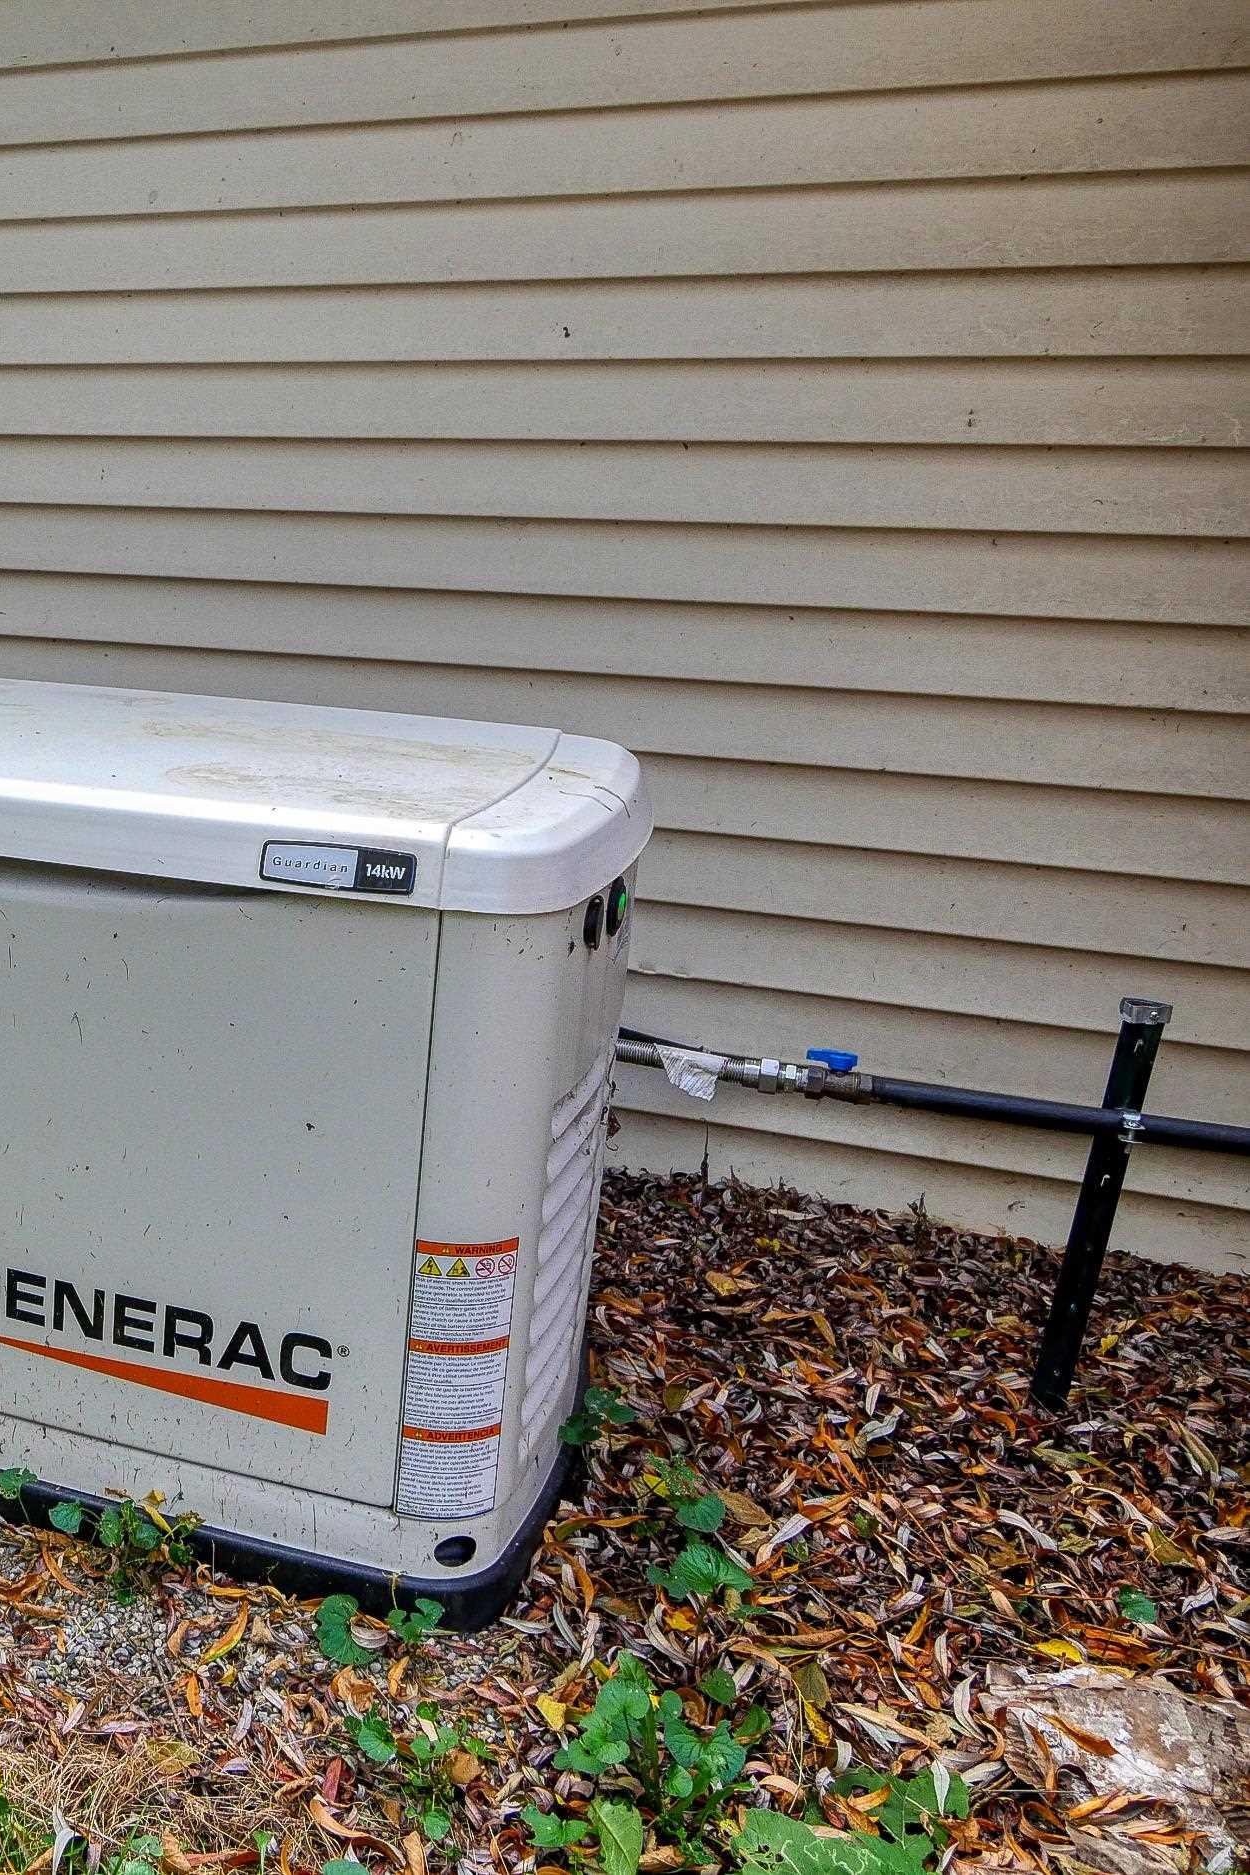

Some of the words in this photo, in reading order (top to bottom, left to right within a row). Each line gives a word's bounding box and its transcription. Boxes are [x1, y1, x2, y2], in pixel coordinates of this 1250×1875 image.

[272, 856, 349, 873] Guardian
[365, 863, 406, 880] 14kW
[455, 1244, 503, 1255] WARNING
[426, 1340, 506, 1354] AVERTISSEMENT
[426, 1427, 495, 1440] ADVERTENCIA
